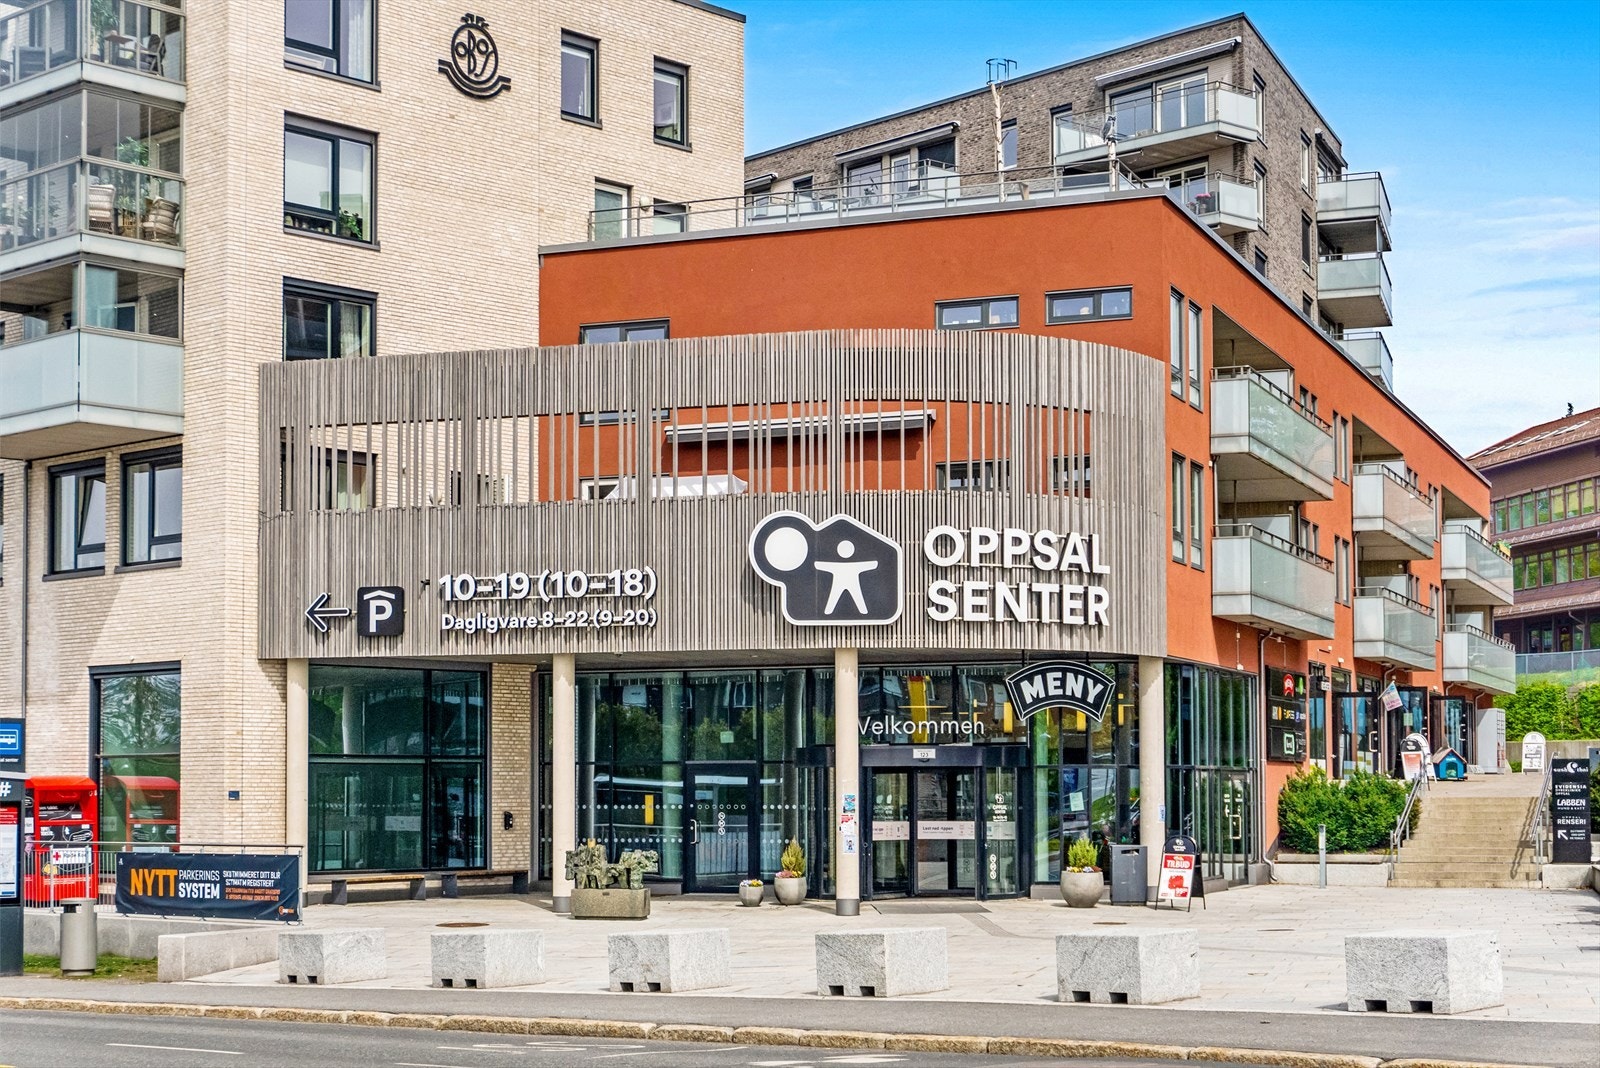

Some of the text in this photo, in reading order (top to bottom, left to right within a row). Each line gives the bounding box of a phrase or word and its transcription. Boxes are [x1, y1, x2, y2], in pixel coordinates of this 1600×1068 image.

[923, 525, 1110, 574] OPPSAL
[369, 600, 393, 633] P
[926, 580, 1110, 627] SENTER
[441, 612, 538, 635] Dagligvare
[1019, 671, 1106, 705] MENY
[858, 715, 985, 735] Velkommen
[130, 869, 178, 897] NYTT
[179, 870, 220, 881] PARKERINGS
[178, 883, 220, 899] SYSTEM
